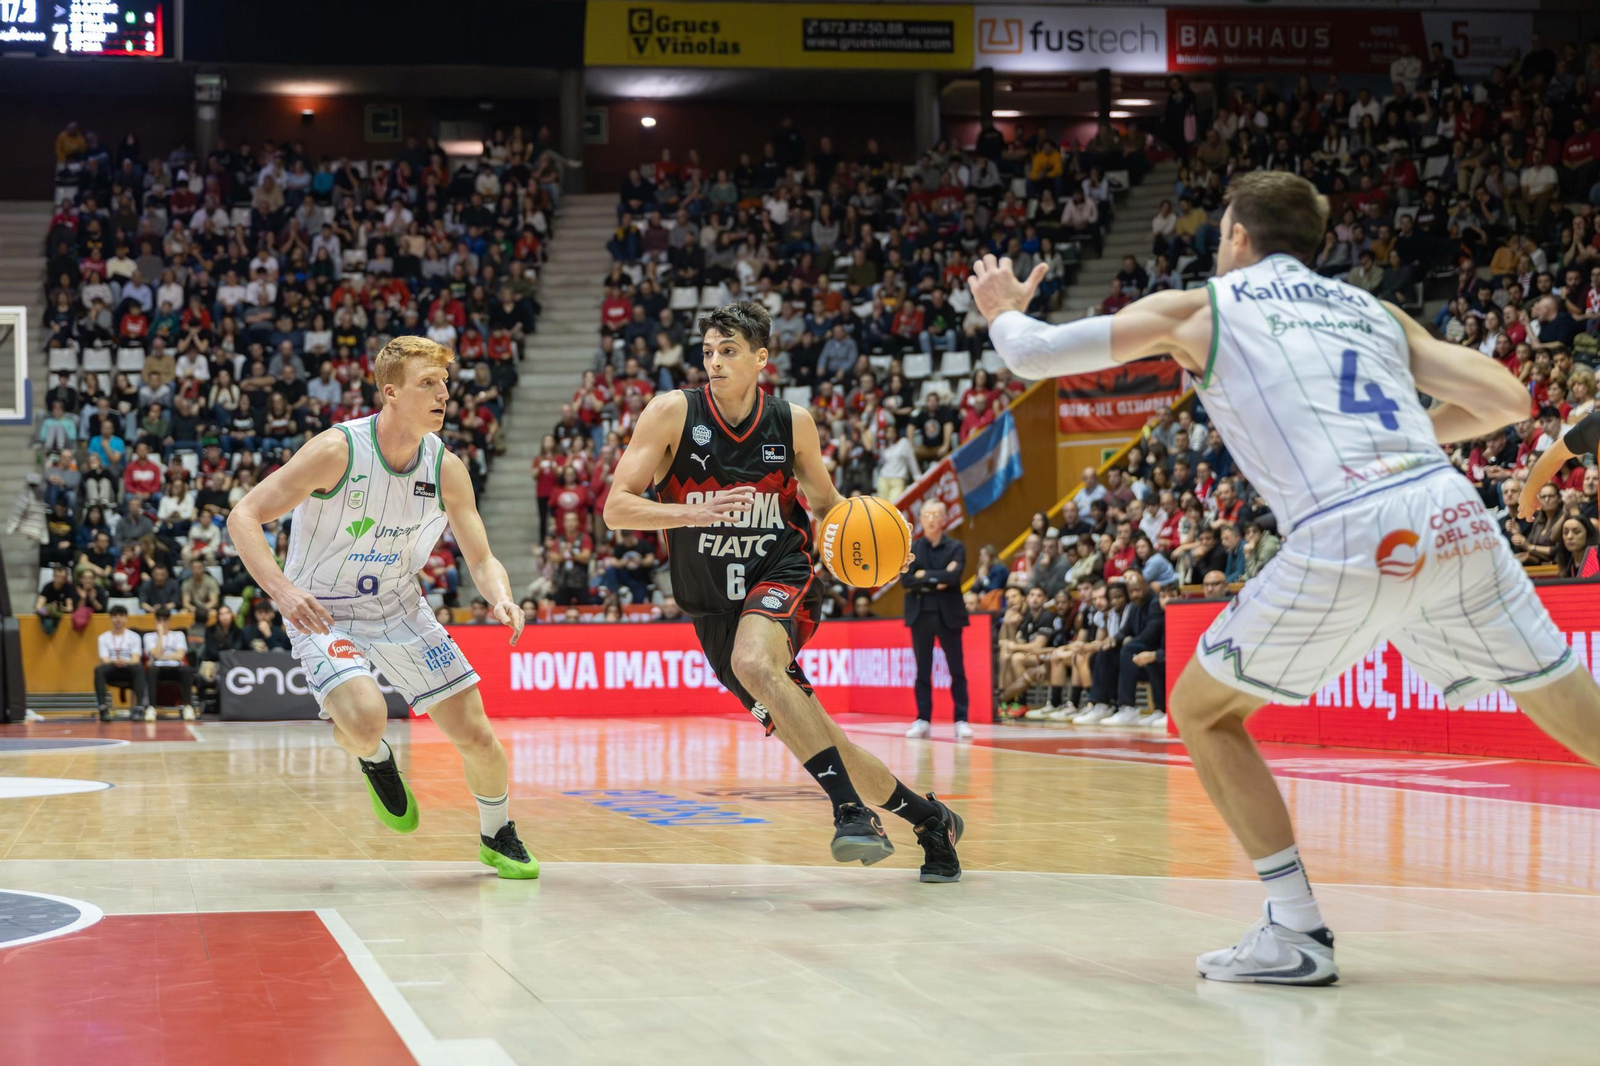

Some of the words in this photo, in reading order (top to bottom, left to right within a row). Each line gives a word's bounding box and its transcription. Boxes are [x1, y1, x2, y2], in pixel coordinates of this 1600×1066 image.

[656, 35, 741, 54] Viñolas
[1029, 21, 1159, 54] fustech
[1180, 25, 1330, 48] BAUHAUS
[1451, 20, 1470, 59] 5
[1339, 349, 1400, 431] 4
[686, 491, 785, 529] ONA
[1430, 500, 1484, 530] COSTA
[698, 533, 777, 558] FIATC
[852, 541, 862, 566] acb
[1435, 527, 1468, 549] DEL
[726, 562, 746, 601] 6
[510, 651, 598, 691] NOVA
